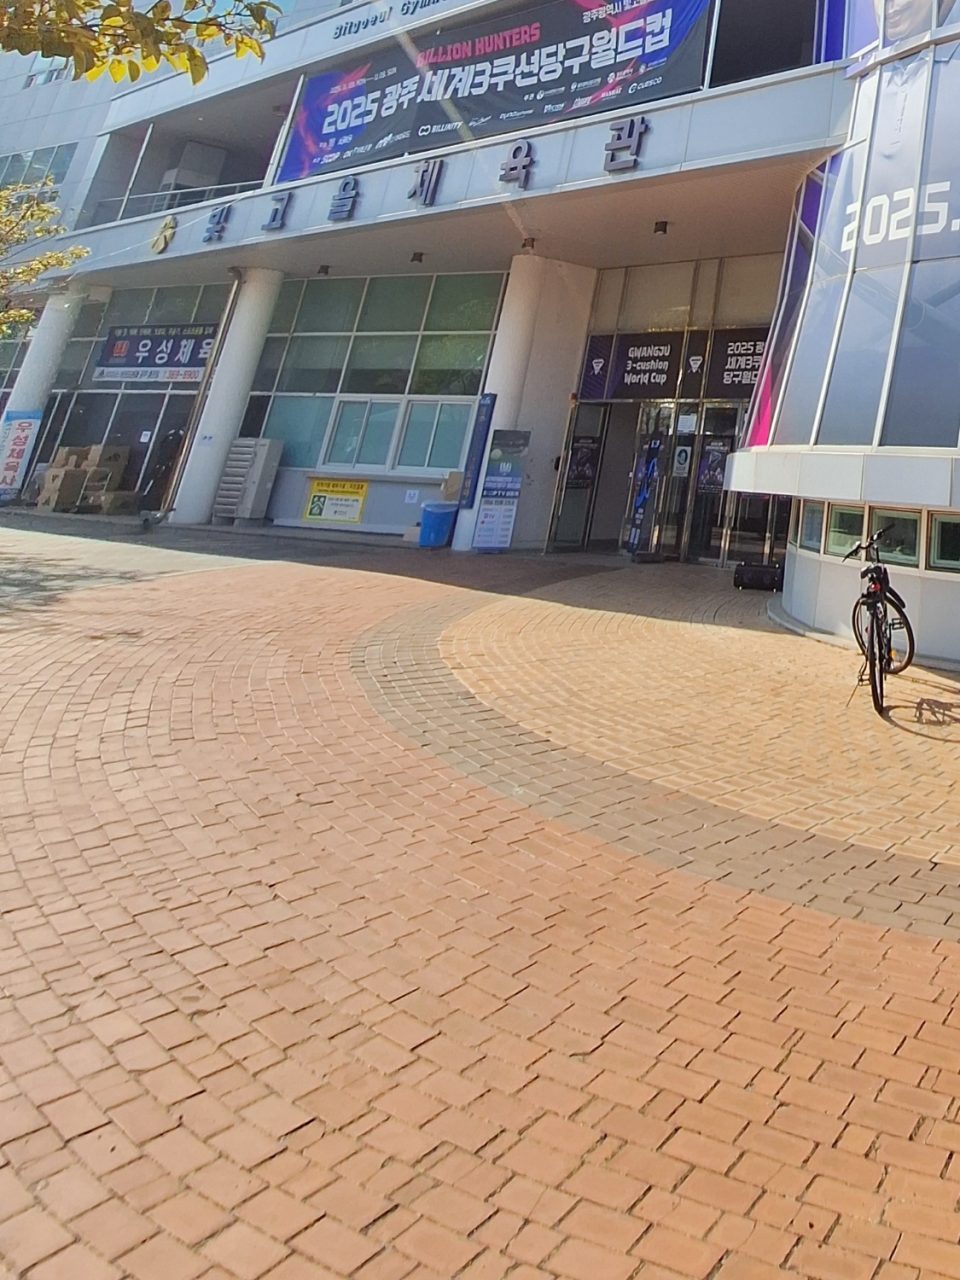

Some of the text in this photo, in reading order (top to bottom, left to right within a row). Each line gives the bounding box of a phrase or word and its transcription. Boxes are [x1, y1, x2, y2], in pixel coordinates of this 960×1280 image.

[582, 1, 622, 23] 광주광역시
[333, 6, 393, 39] Bitgoeul
[416, 22, 541, 68] BILLION HUNTERS
[322, 90, 381, 134] 2025
[381, 75, 420, 117] 광주
[628, 344, 670, 358] GWANGJU
[727, 342, 754, 354] 2025
[626, 356, 669, 370] 3-cushion
[624, 372, 667, 386] World Cup
